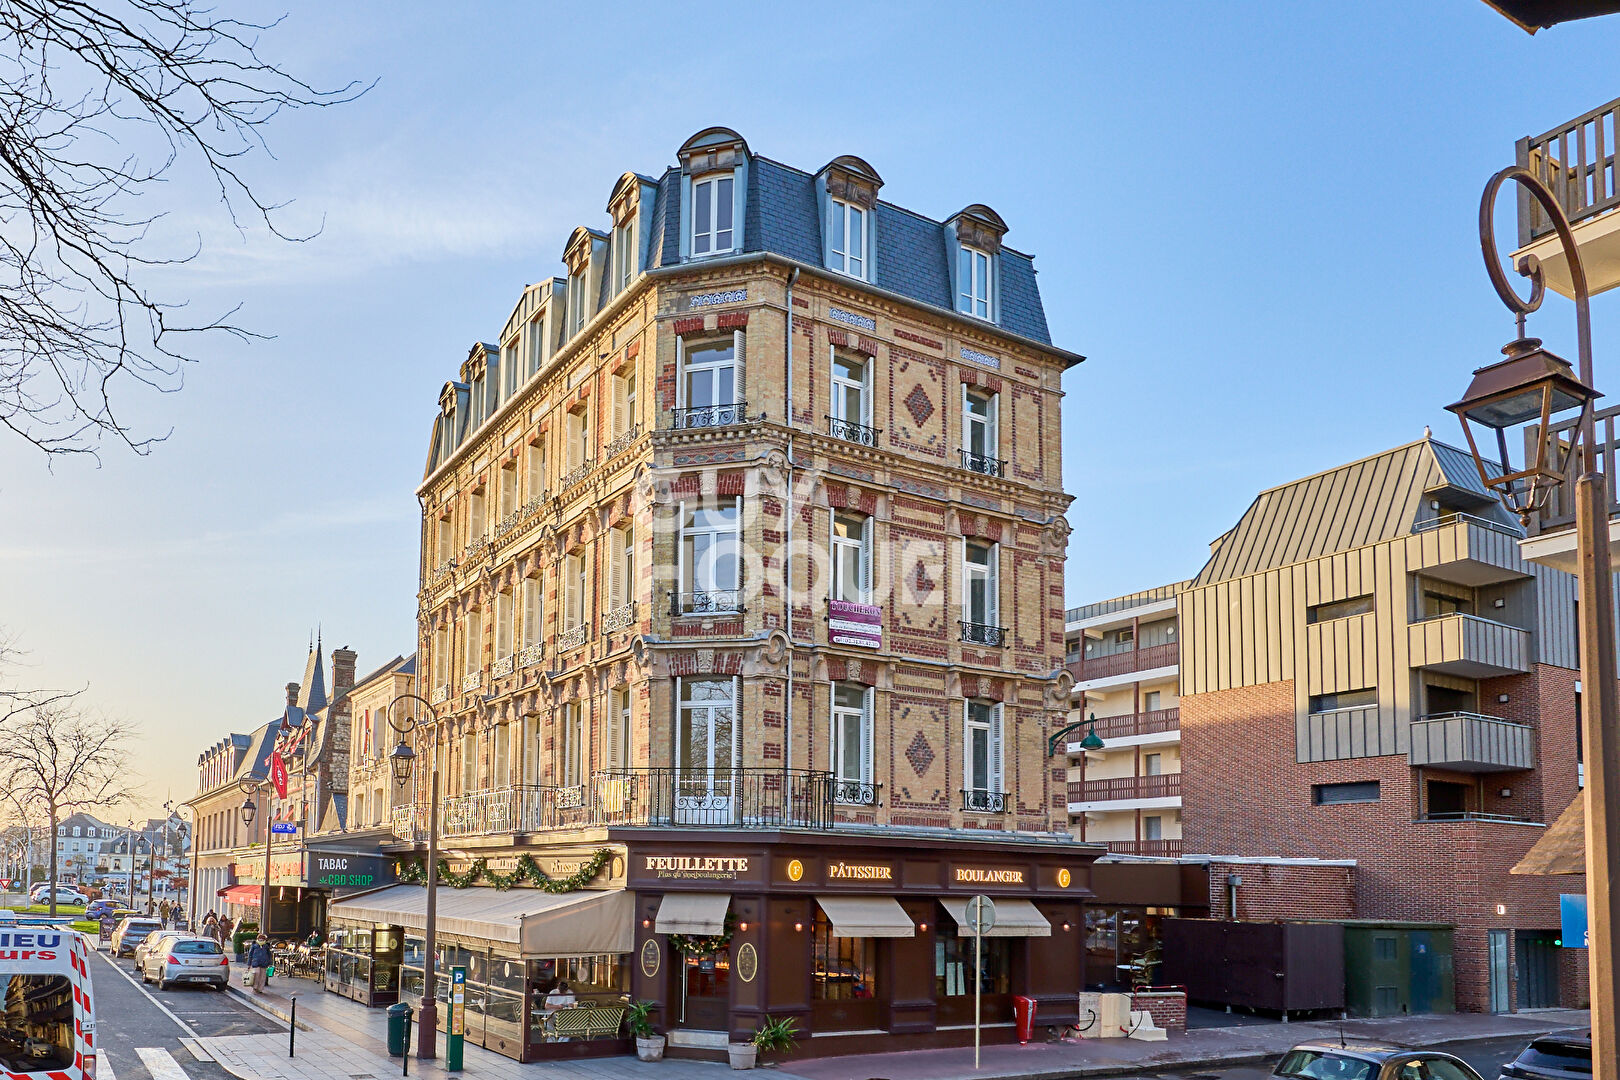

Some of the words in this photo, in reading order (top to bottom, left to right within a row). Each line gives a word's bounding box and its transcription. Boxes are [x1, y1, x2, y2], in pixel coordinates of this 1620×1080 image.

[318, 858, 348, 870] TABAC
[645, 856, 748, 871] FEUILLETTE
[829, 862, 892, 879] PÂTISSIER
[956, 868, 1023, 882] BOULANGER
[328, 874, 346, 886] CBD
[349, 874, 373, 886] SHOP
[456, 973, 463, 982] P
